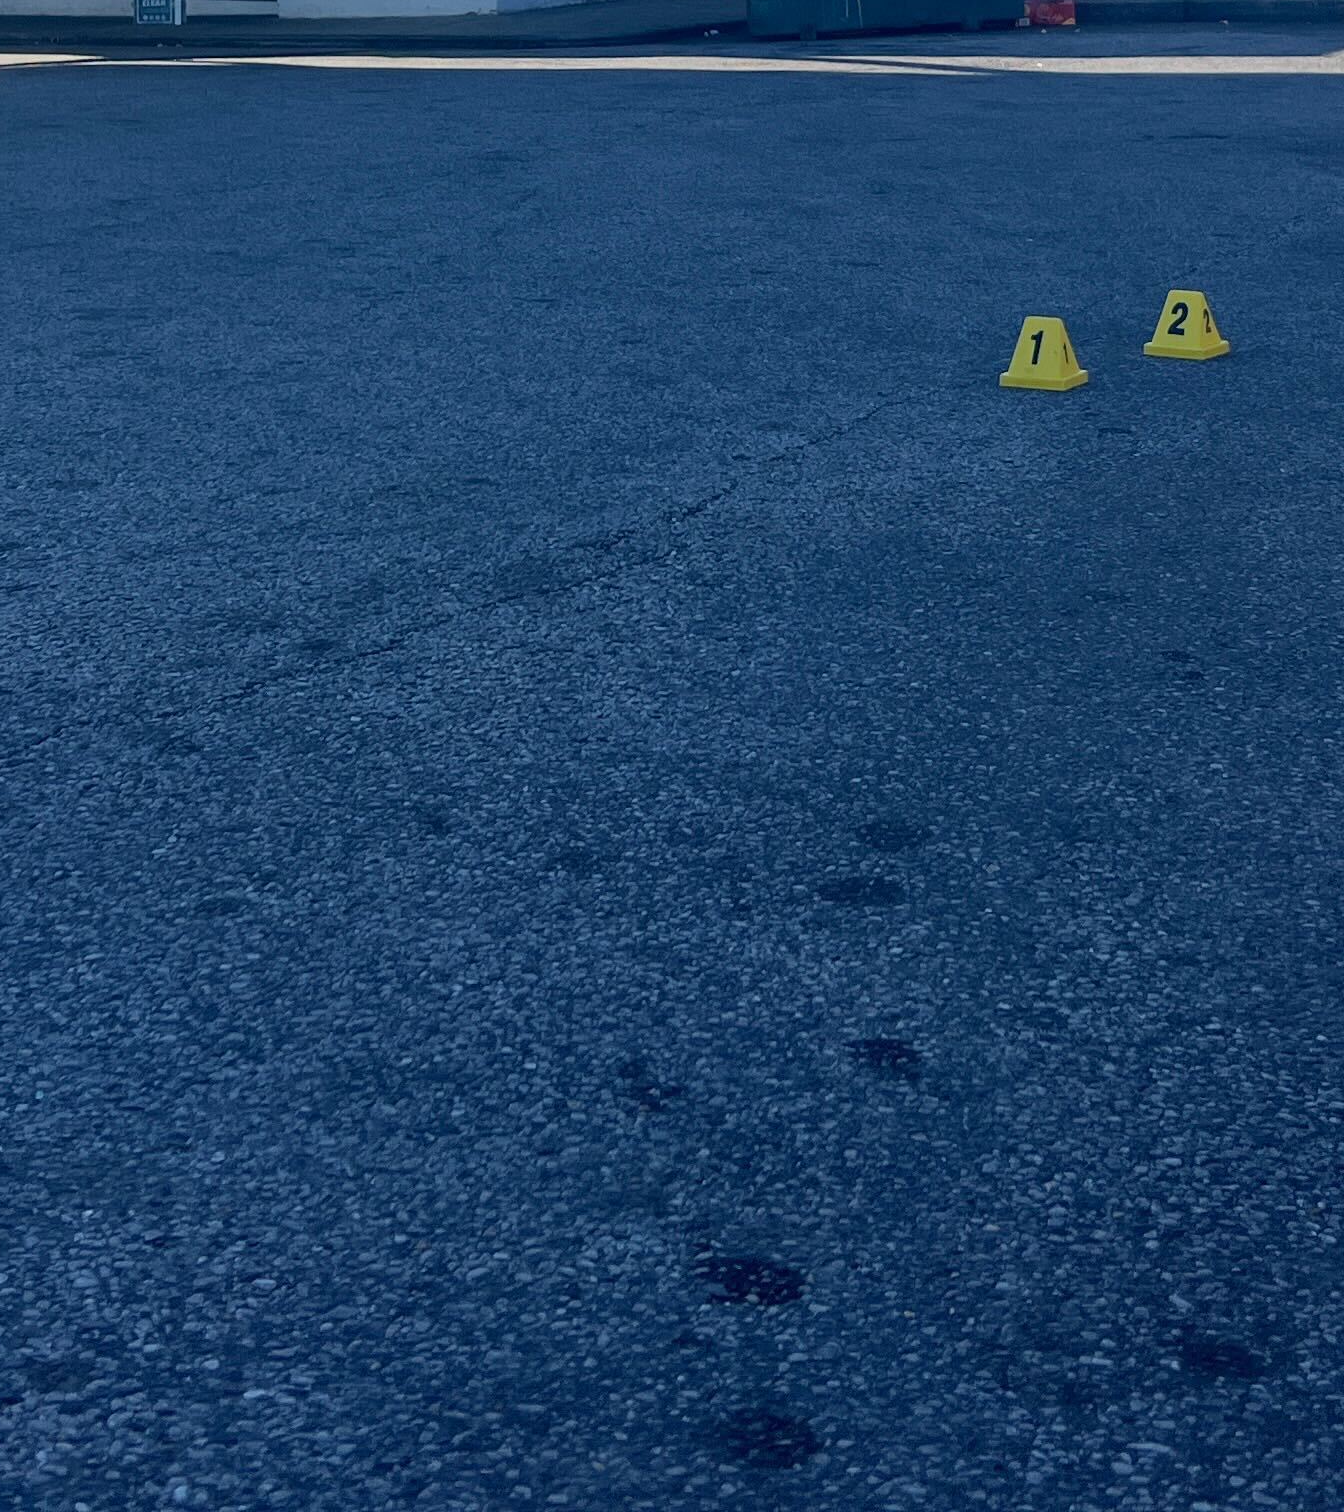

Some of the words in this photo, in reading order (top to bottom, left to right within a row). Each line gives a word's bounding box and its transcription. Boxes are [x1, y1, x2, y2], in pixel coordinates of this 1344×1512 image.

[1167, 301, 1189, 336] 2
[1203, 308, 1213, 334] 2
[1030, 329, 1045, 366] 1
[1063, 342, 1071, 365] 1
